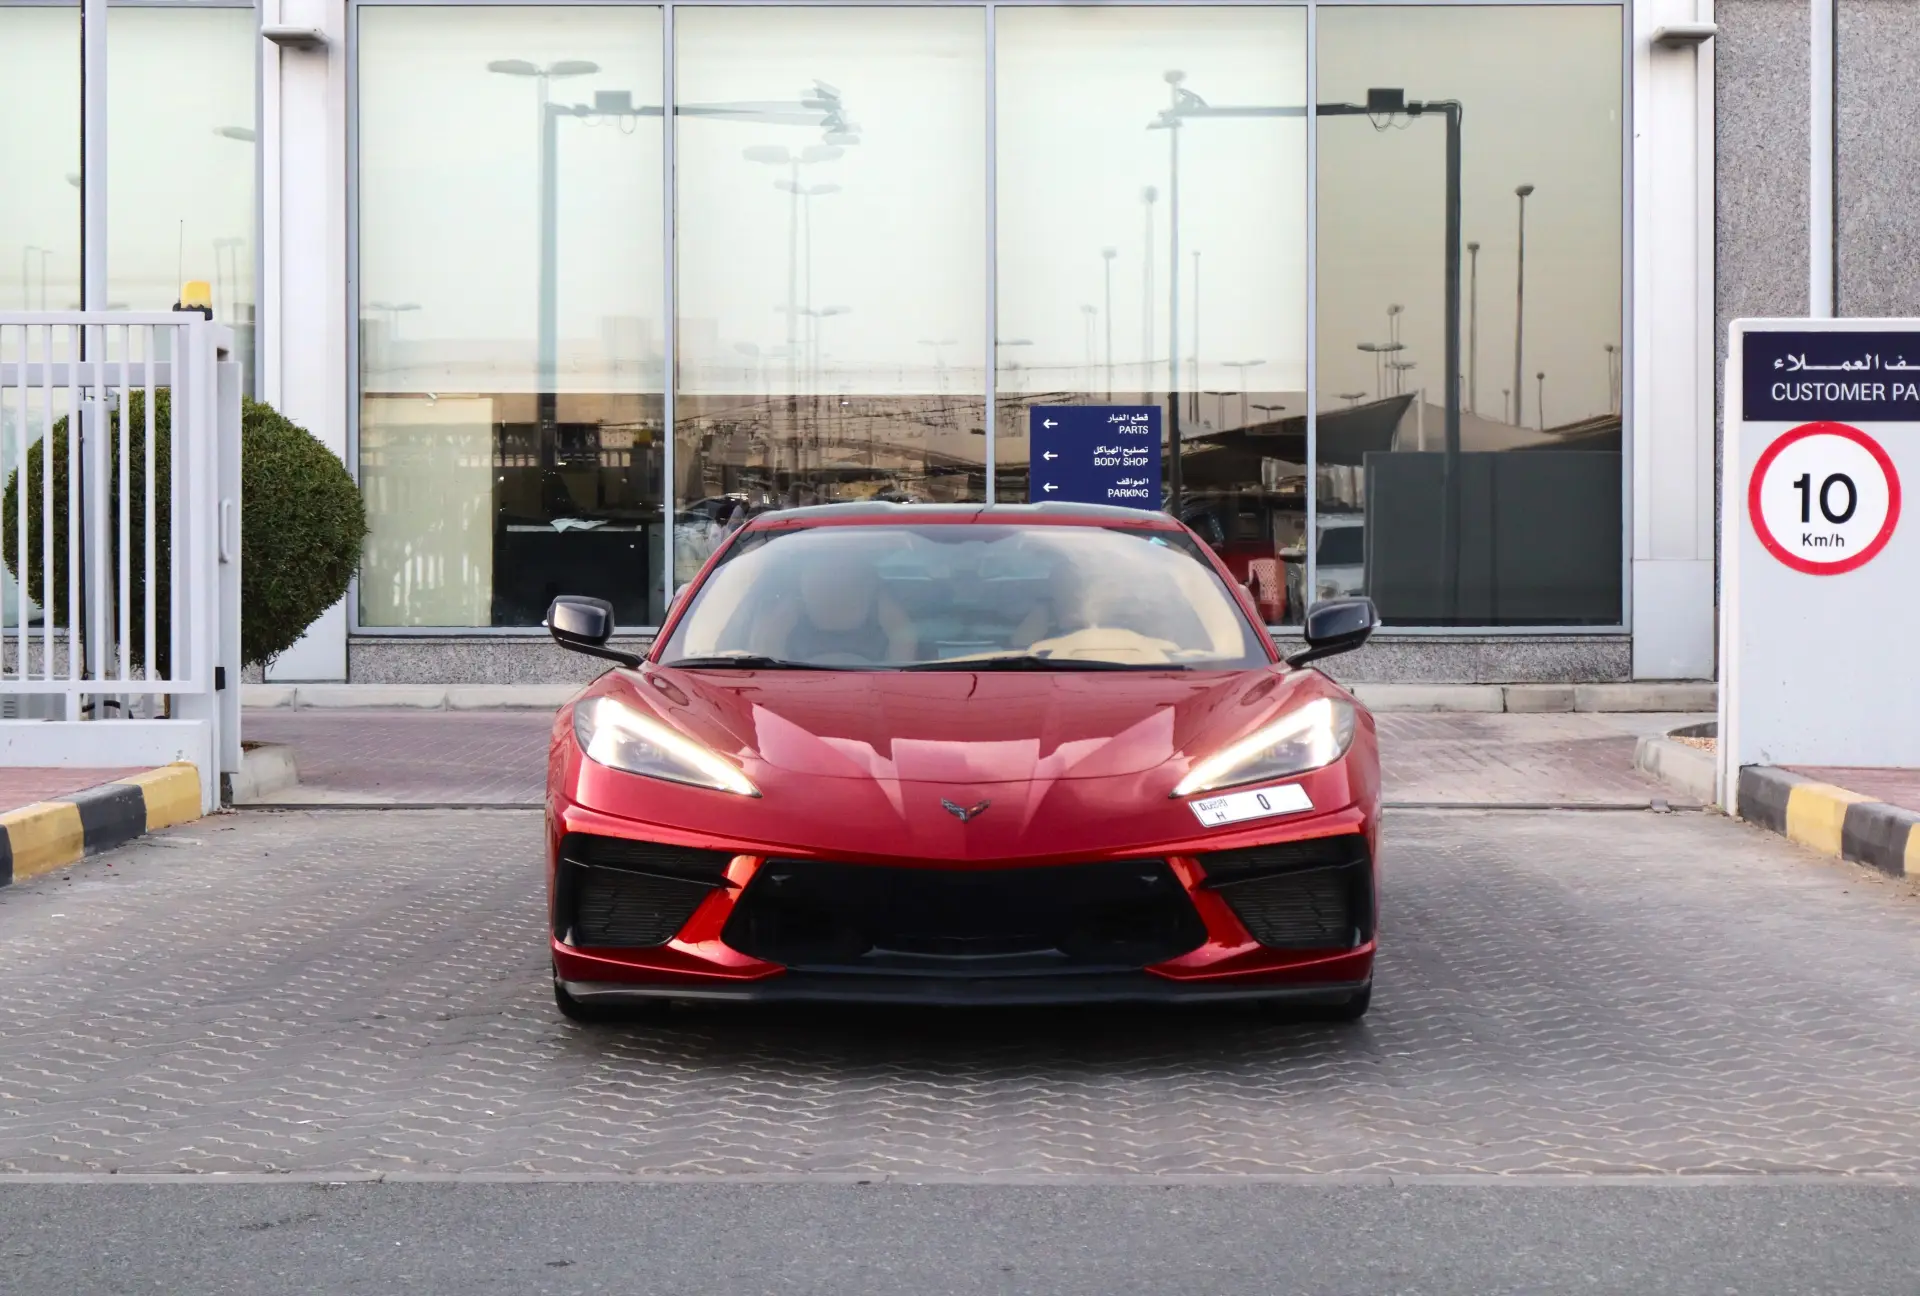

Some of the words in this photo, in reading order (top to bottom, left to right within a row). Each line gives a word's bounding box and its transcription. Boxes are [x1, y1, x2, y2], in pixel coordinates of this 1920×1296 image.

[1771, 382, 1886, 401] CUSTOMER
[1893, 383, 1920, 401] PA
[1107, 413, 1129, 423] الغيار
[1130, 413, 1149, 424] قطع
[1119, 425, 1149, 435] PARTS
[1093, 445, 1122, 455] الهياكل
[1122, 445, 1149, 456] تصليح
[1094, 457, 1121, 466] BODY
[1123, 457, 1149, 466] SHOP
[1116, 478, 1149, 487] المواقف
[1107, 488, 1149, 498] PARKING
[1793, 472, 1858, 525] 10
[1802, 533, 1845, 547] Km/h
